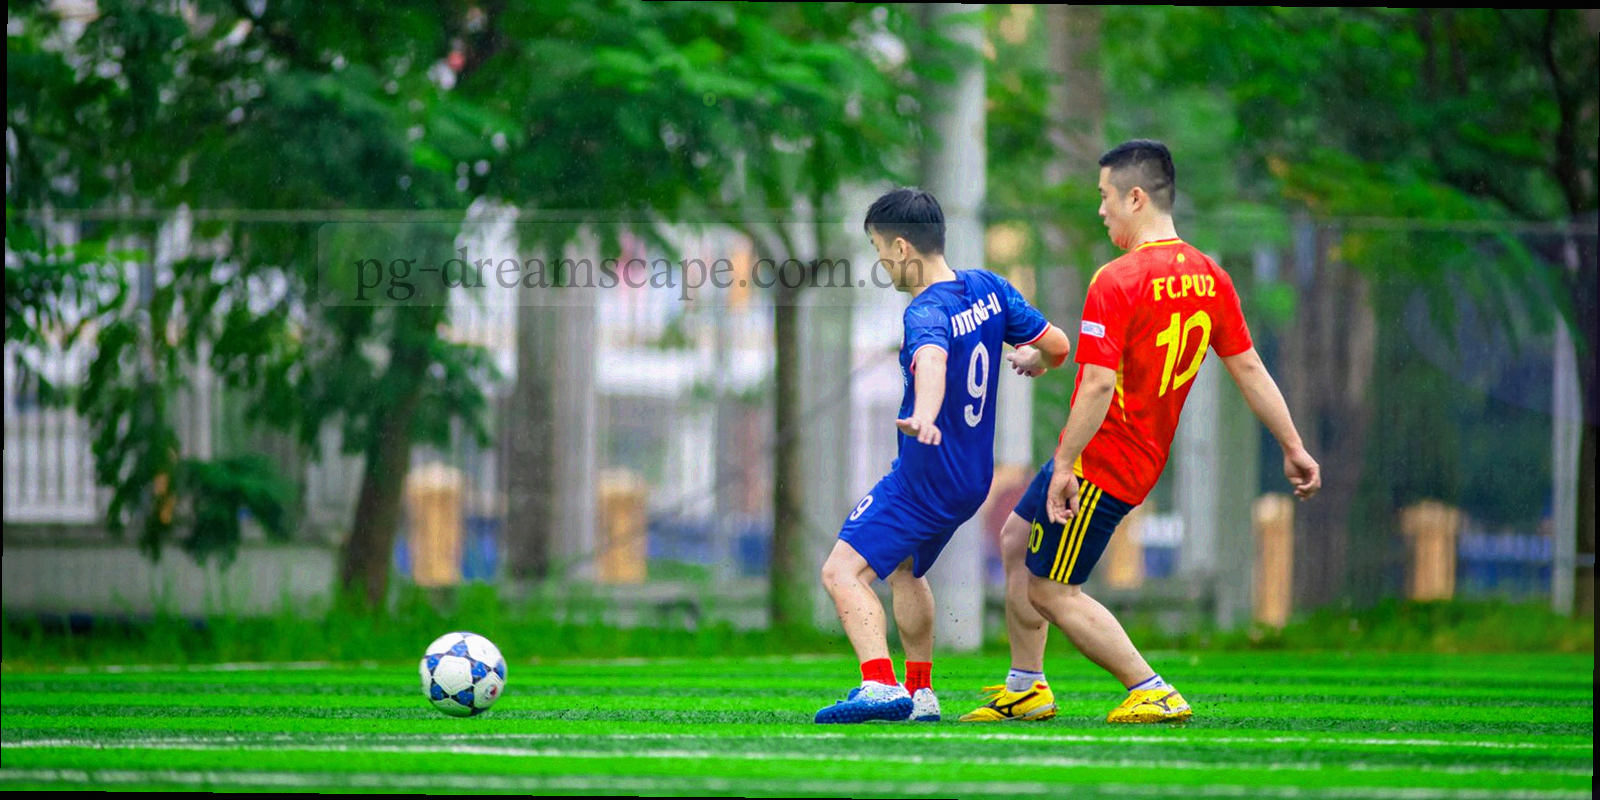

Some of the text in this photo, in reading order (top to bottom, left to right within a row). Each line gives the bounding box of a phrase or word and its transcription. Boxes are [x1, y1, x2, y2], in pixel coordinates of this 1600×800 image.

[964, 341, 990, 428] 9
[1155, 310, 1212, 397] 10
[850, 495, 873, 521] 9
